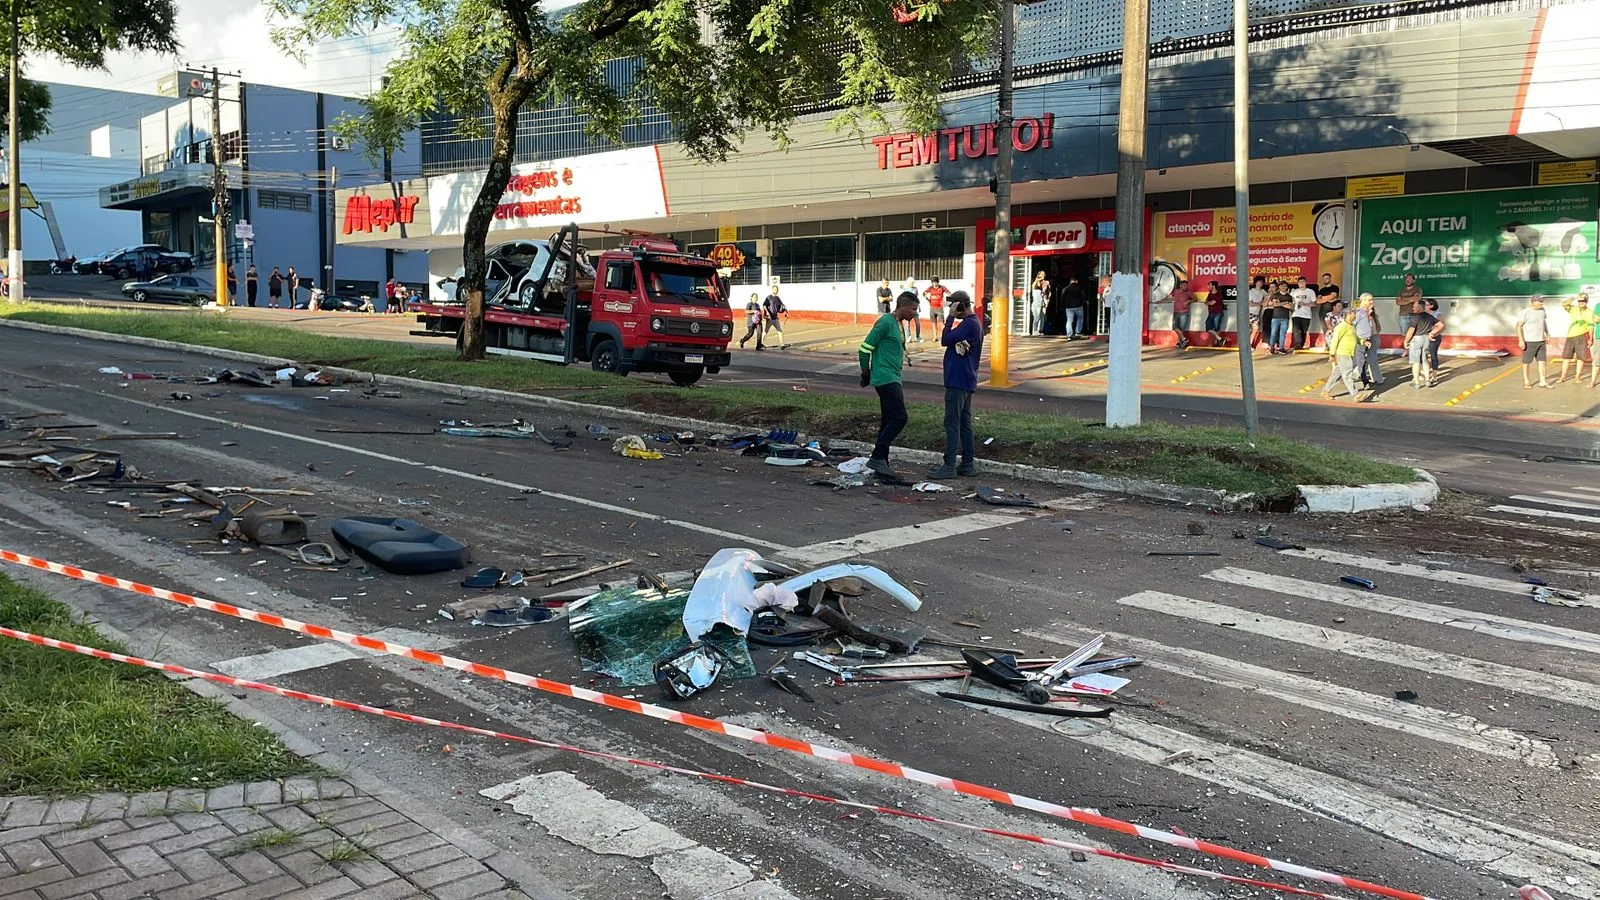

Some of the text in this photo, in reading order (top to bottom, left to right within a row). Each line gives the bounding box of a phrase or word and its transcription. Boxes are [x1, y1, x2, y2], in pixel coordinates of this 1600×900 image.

[872, 130, 939, 170] TEM
[505, 167, 573, 196] ragens e
[343, 195, 420, 235] Mepar
[494, 196, 582, 220] erramentas
[1220, 215, 1237, 224] Nov
[1281, 211, 1294, 220] de
[1168, 221, 1211, 236] atenção
[1220, 223, 1294, 234] Funnamento
[1380, 216, 1467, 235] AQUI TEM
[1028, 228, 1082, 246] Mepar
[717, 247, 732, 259] 40
[1195, 253, 1226, 264] novo
[1249, 256, 1278, 265] egunda
[1285, 255, 1307, 263] Sexta
[1370, 240, 1470, 271] Zagonel
[720, 259, 734, 267] NOS
[1195, 263, 1237, 276] horário
[1250, 266, 1276, 274] 07:45h
[1277, 265, 1287, 273] às
